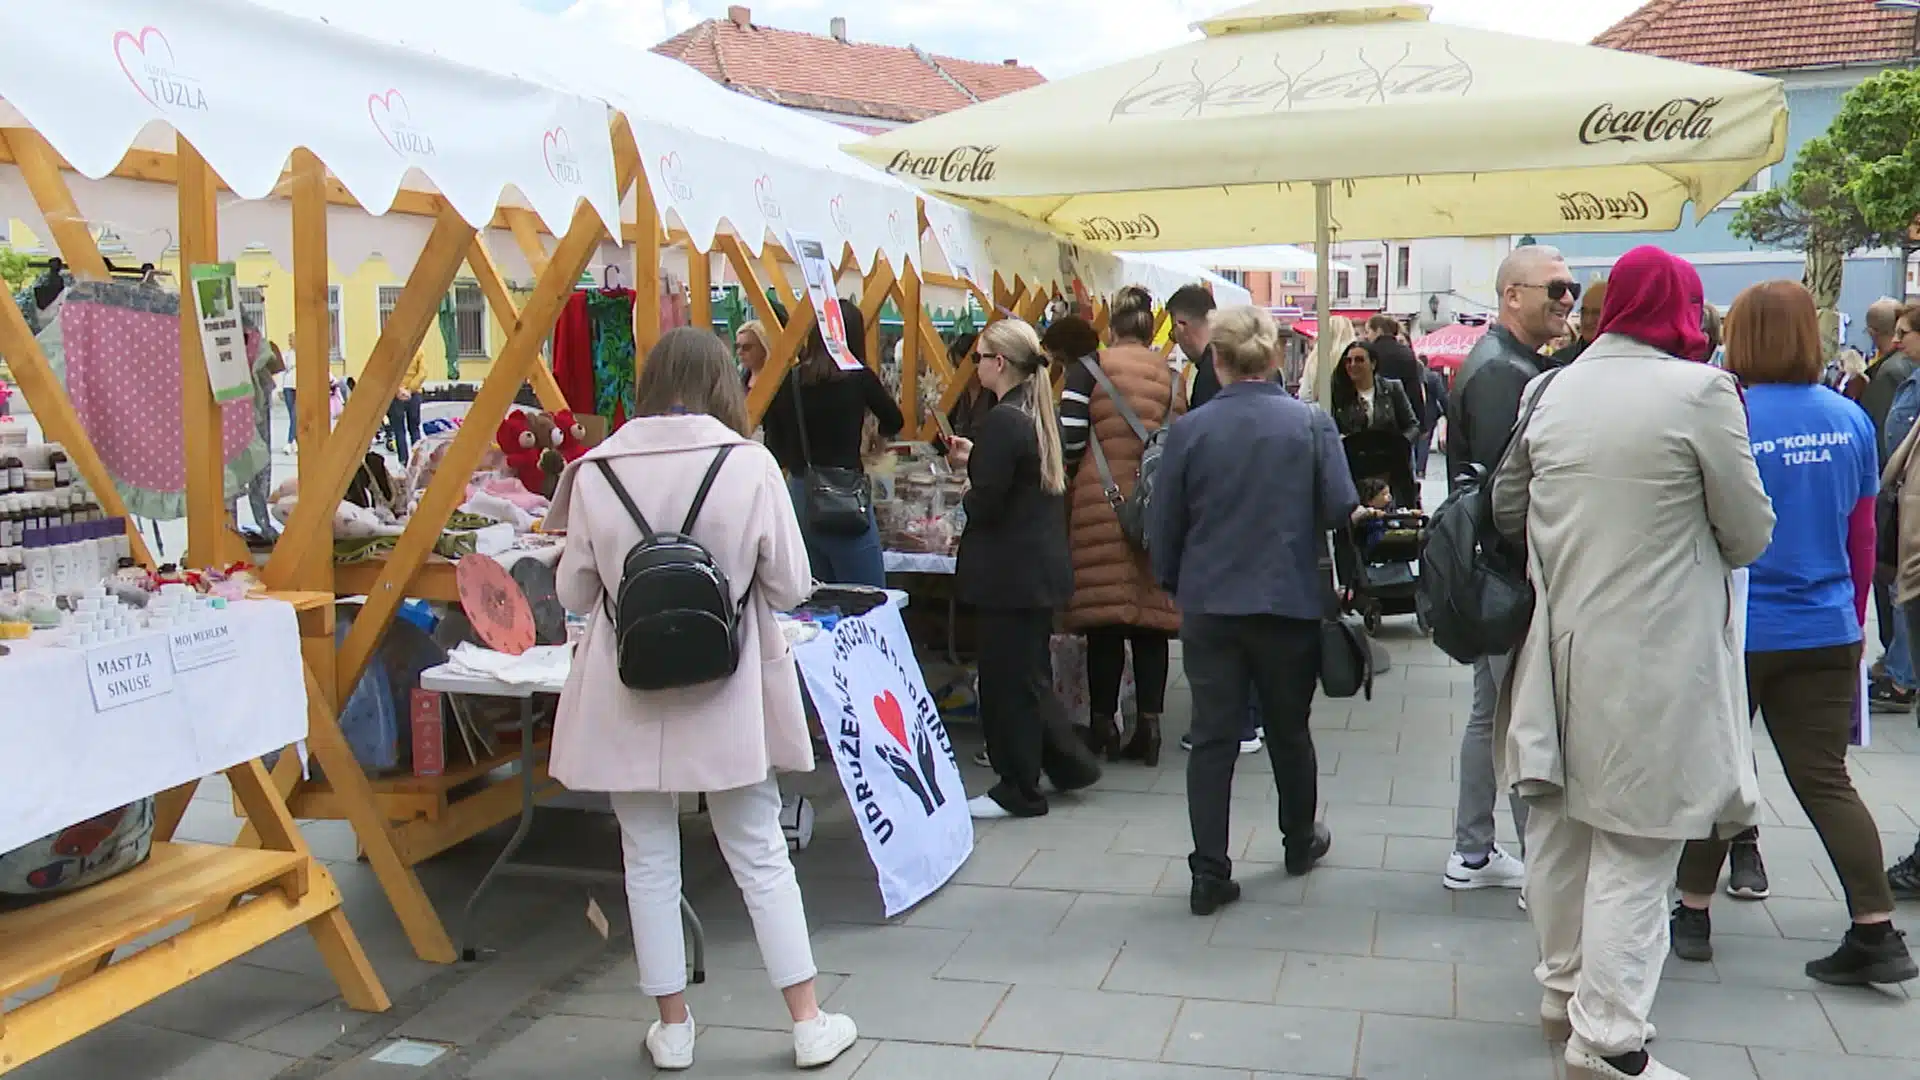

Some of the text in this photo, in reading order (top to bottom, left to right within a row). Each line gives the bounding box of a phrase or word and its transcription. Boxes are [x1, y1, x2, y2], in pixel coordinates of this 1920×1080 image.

[148, 76, 209, 112] TUZLA
[1578, 96, 1724, 145] Coca-Cola
[393, 129, 437, 157] TUZLA
[555, 163, 584, 185] TUZLA
[885, 144, 999, 183] Coca-Cola
[1776, 432, 1853, 450] "KONJUH"
[1782, 448, 1832, 466] TUZLA
[174, 633, 193, 647] MOJ
[97, 655, 133, 677] MAST
[135, 651, 153, 669] ZA
[107, 673, 152, 699] SINUSE
[832, 665, 894, 846] UDRUŽENJE
